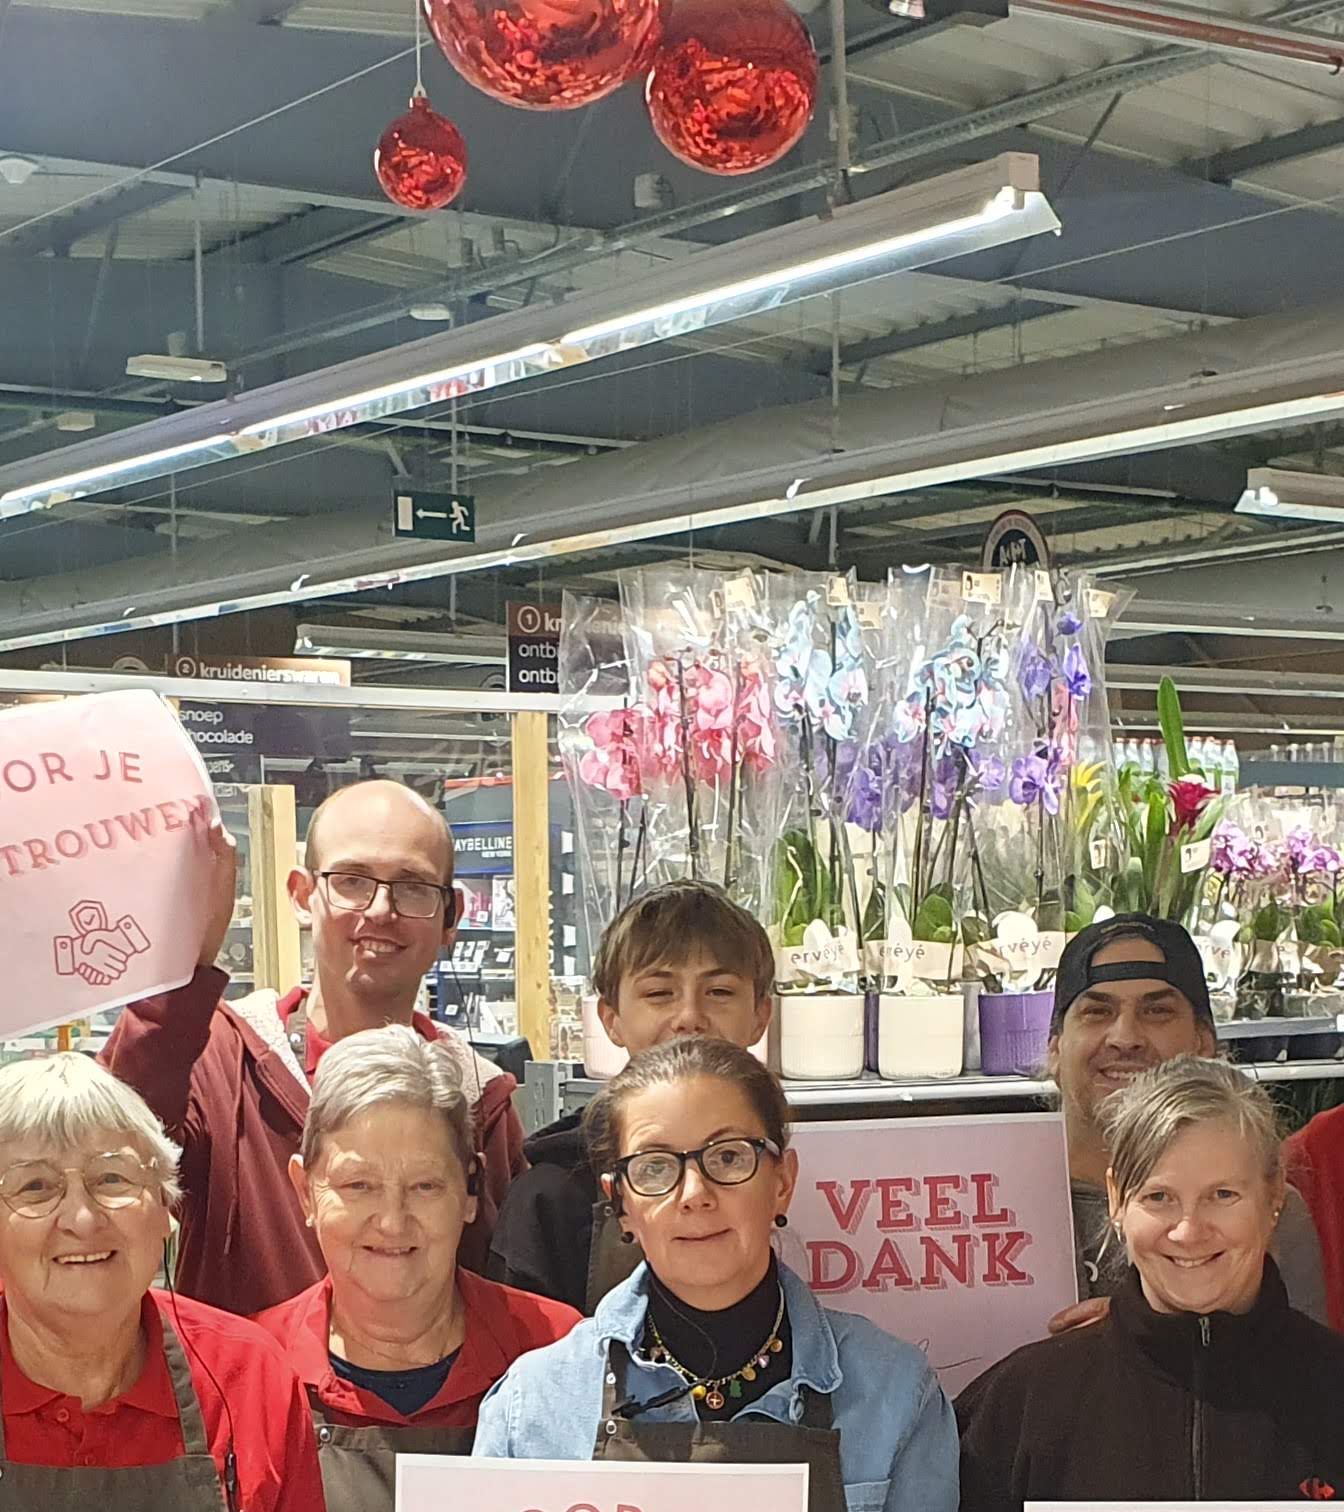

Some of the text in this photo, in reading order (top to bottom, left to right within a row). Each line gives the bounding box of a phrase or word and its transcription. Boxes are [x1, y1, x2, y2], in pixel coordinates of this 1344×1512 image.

[200, 662, 340, 684] kruidenierswaren
[178, 709, 224, 724] snoep
[93, 750, 143, 784] JE
[453, 836, 512, 851] AYBELLINE
[816, 1173, 1017, 1233] VEEL
[806, 1231, 1034, 1295] DANK
